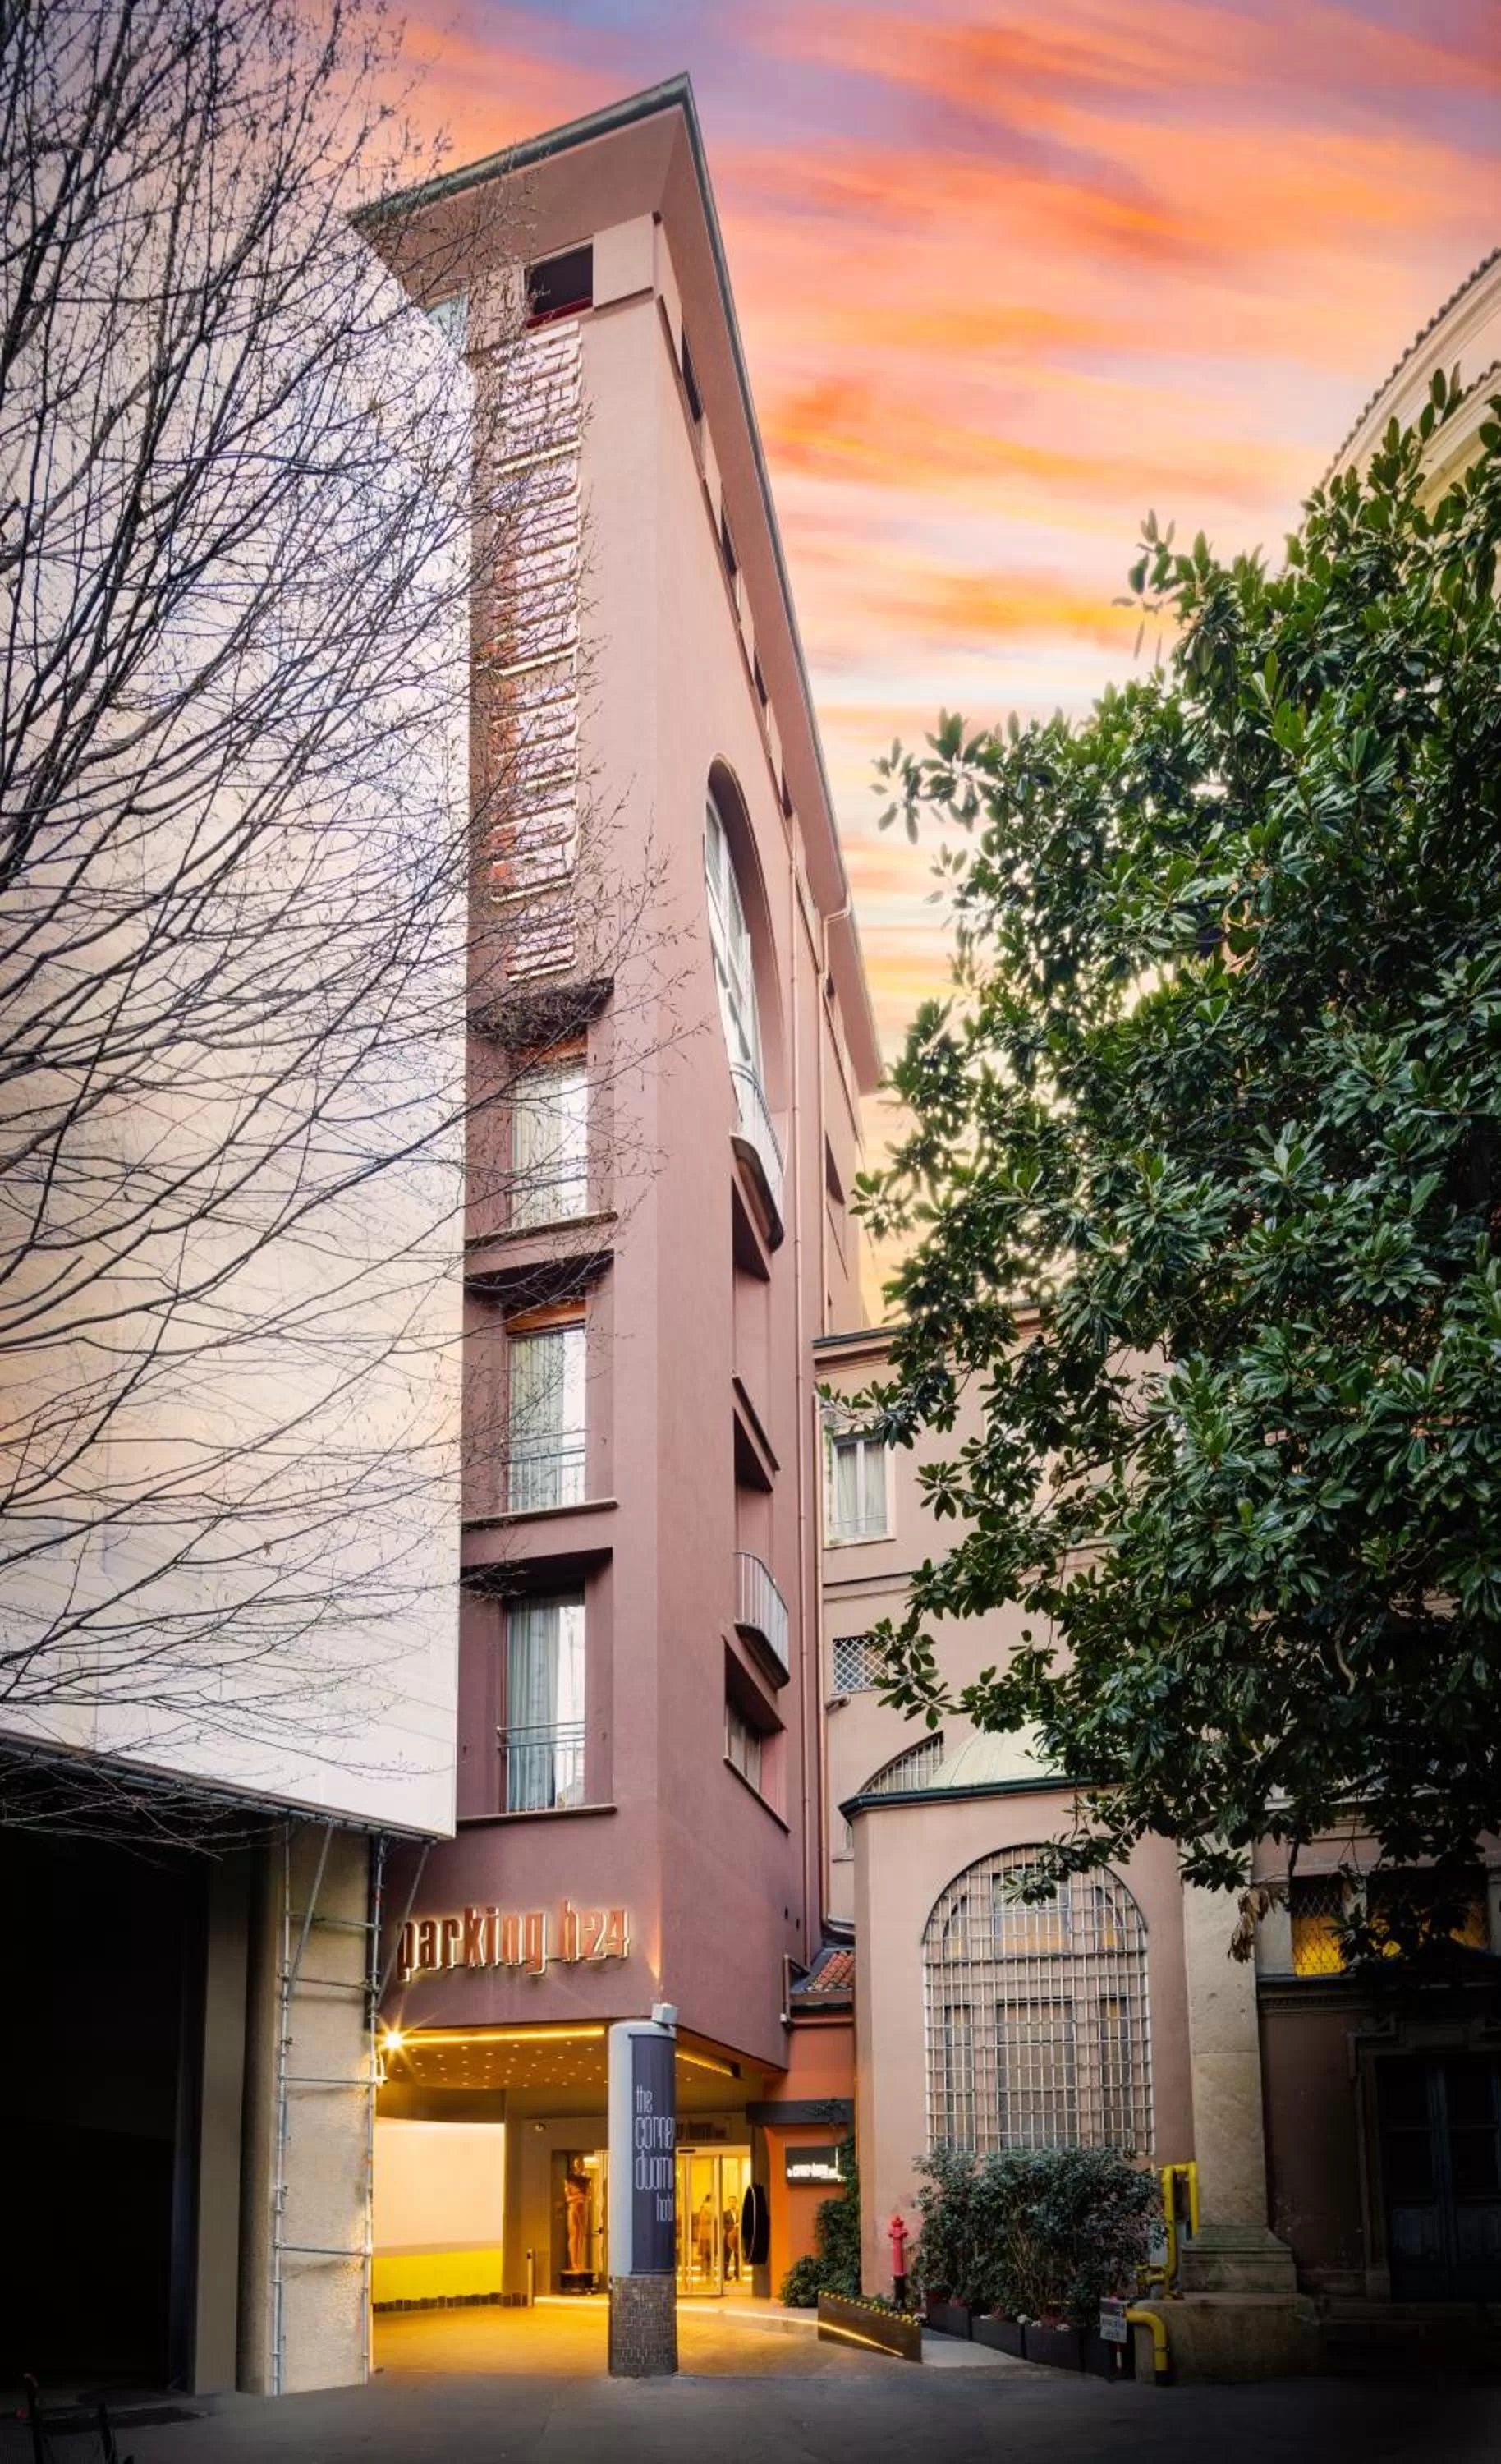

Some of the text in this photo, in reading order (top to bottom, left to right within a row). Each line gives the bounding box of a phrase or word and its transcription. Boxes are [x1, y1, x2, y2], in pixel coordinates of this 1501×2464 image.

[397, 1899, 630, 1982] parking h24
[636, 2084, 654, 2113] the
[635, 2117, 675, 2149] corne
